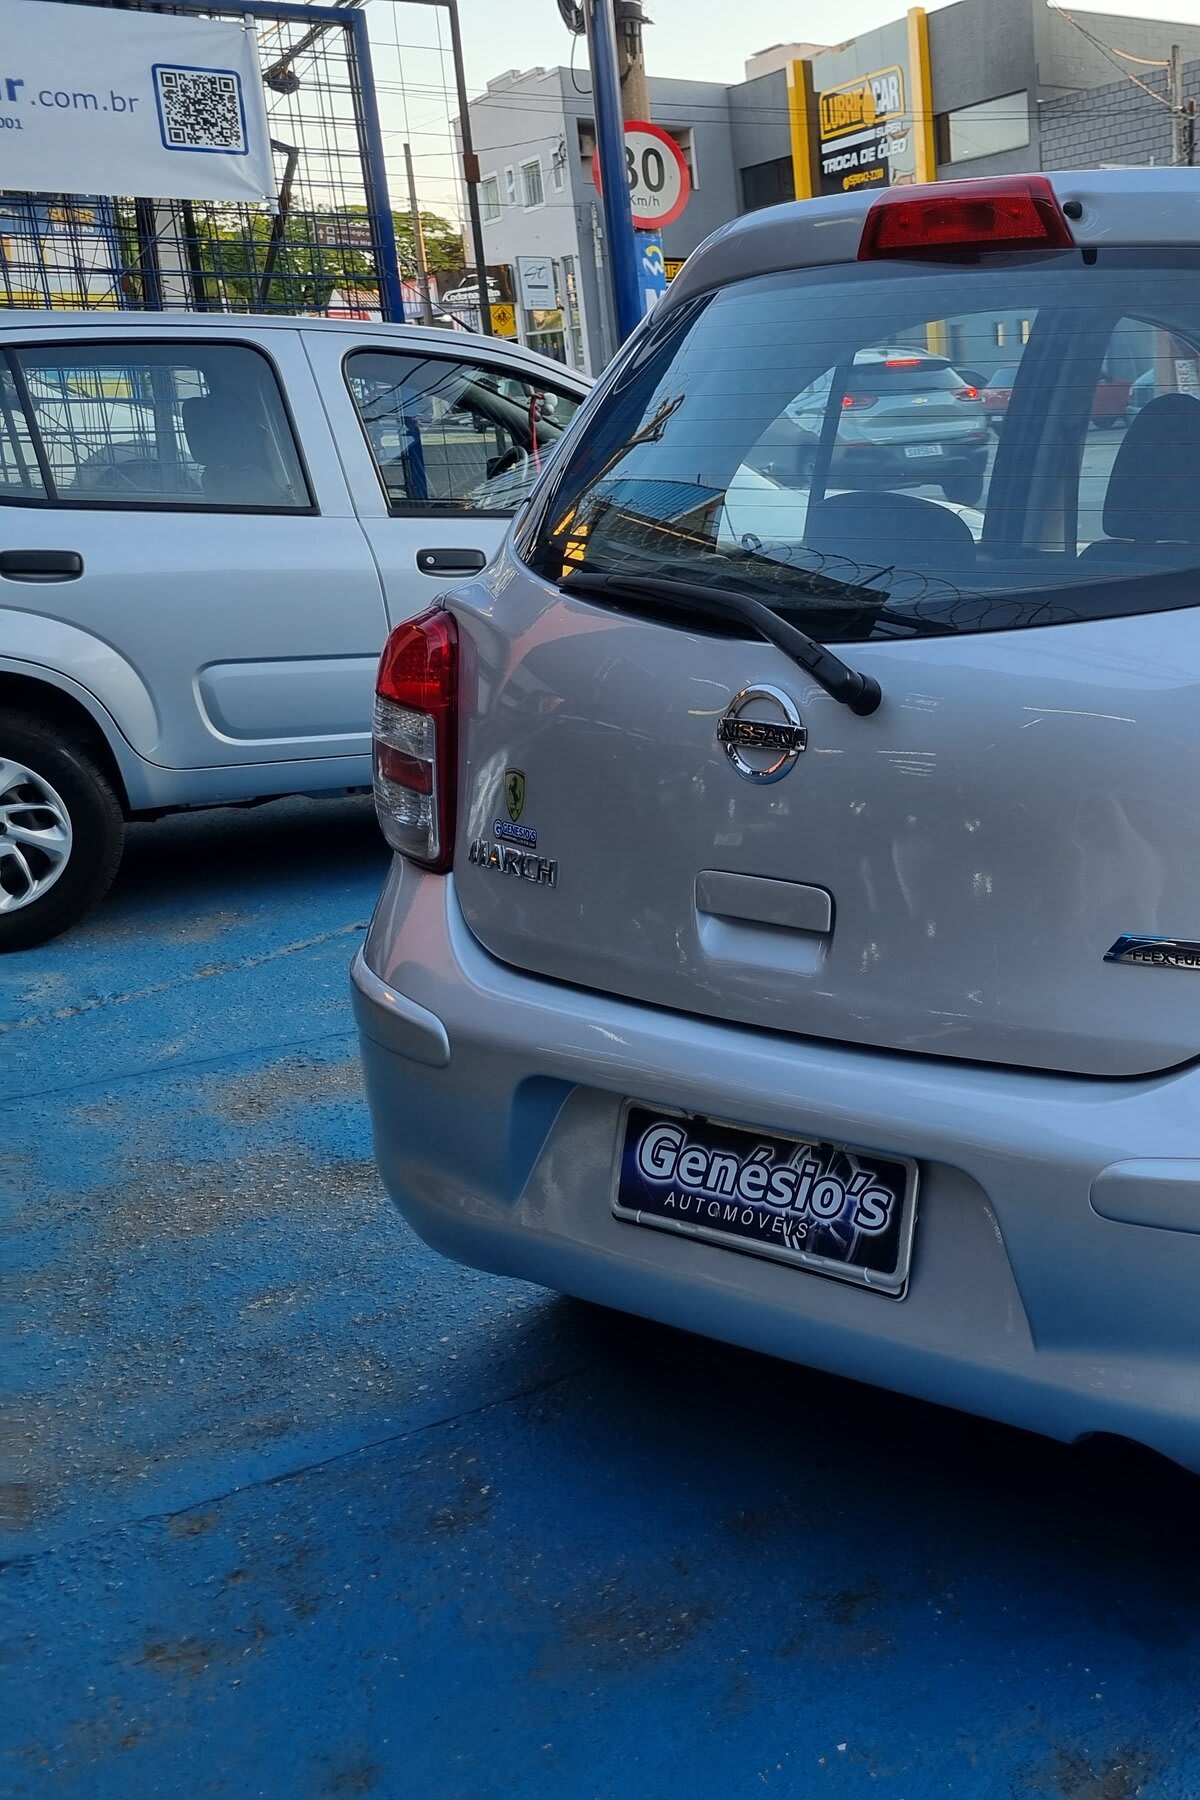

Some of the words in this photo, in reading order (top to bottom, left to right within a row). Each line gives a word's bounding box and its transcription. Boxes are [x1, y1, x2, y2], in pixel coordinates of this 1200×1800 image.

[822, 152, 859, 174] TROCA
[860, 147, 877, 165] DE
[877, 138, 907, 160] ÓLEO
[723, 721, 798, 747] NISSAN
[468, 838, 558, 888] MARCH
[1132, 950, 1172, 965] FLEX
[638, 1123, 895, 1232] Genésio's
[663, 1190, 809, 1239] AUTOMÓVEIS
